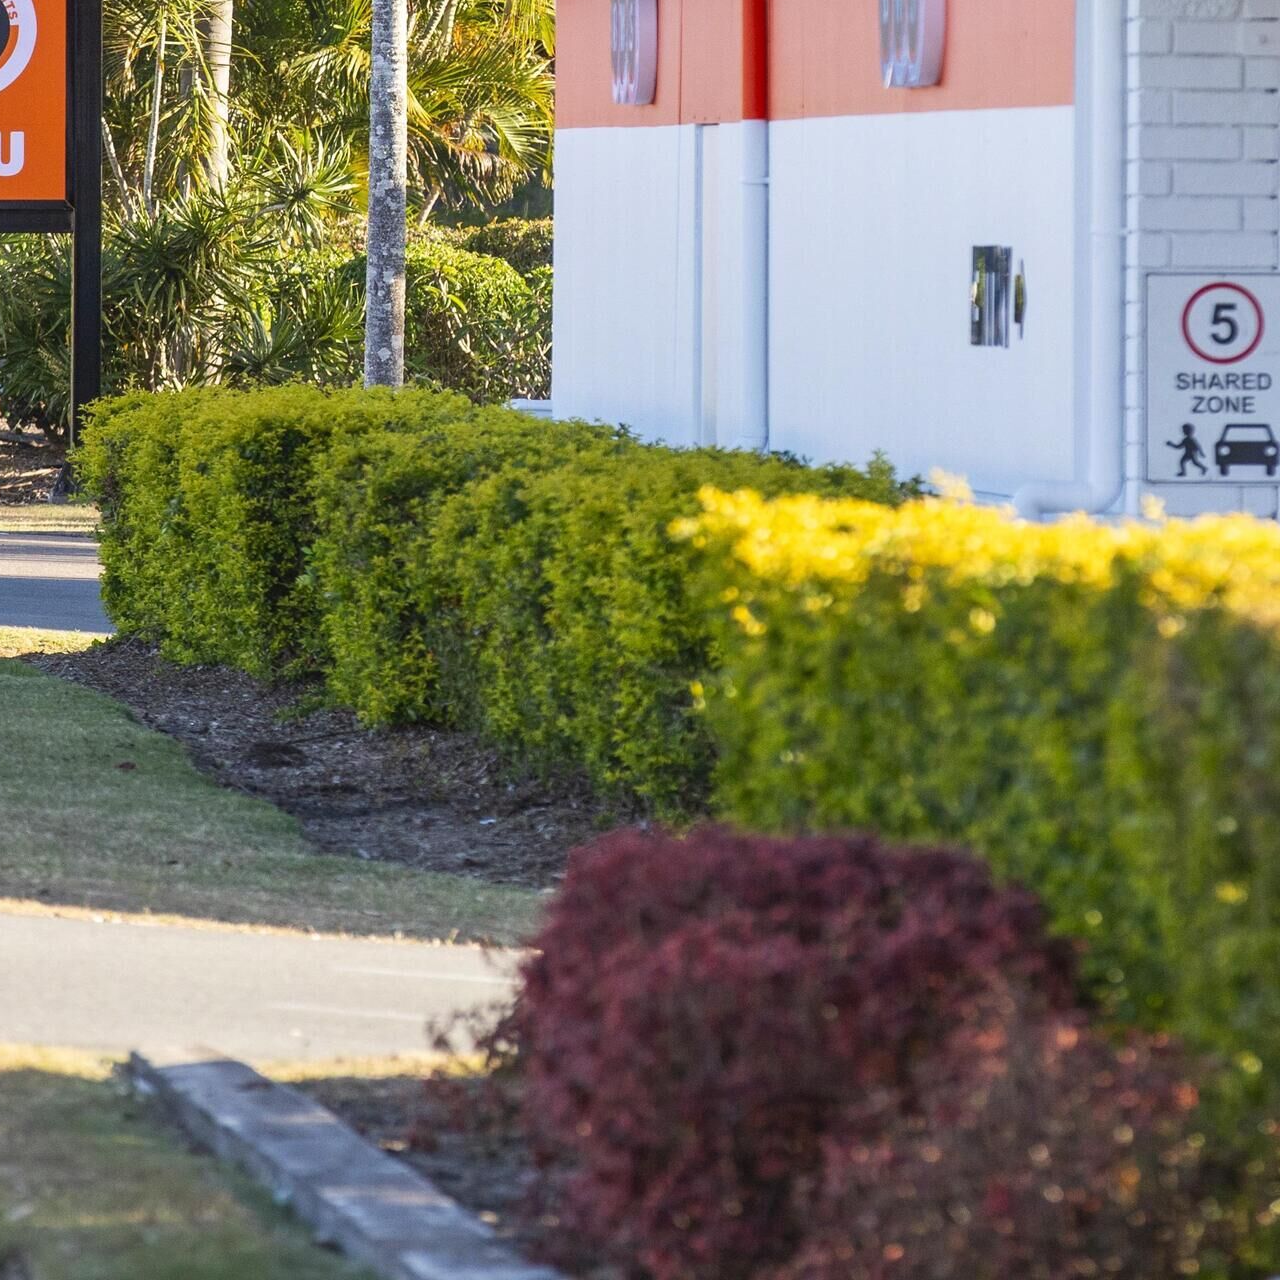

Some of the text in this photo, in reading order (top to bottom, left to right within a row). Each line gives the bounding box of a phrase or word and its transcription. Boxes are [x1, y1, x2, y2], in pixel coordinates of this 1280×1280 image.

[1210, 302, 1239, 346] 5
[1175, 372, 1273, 391] SHARED
[1191, 395, 1256, 414] ZONE
